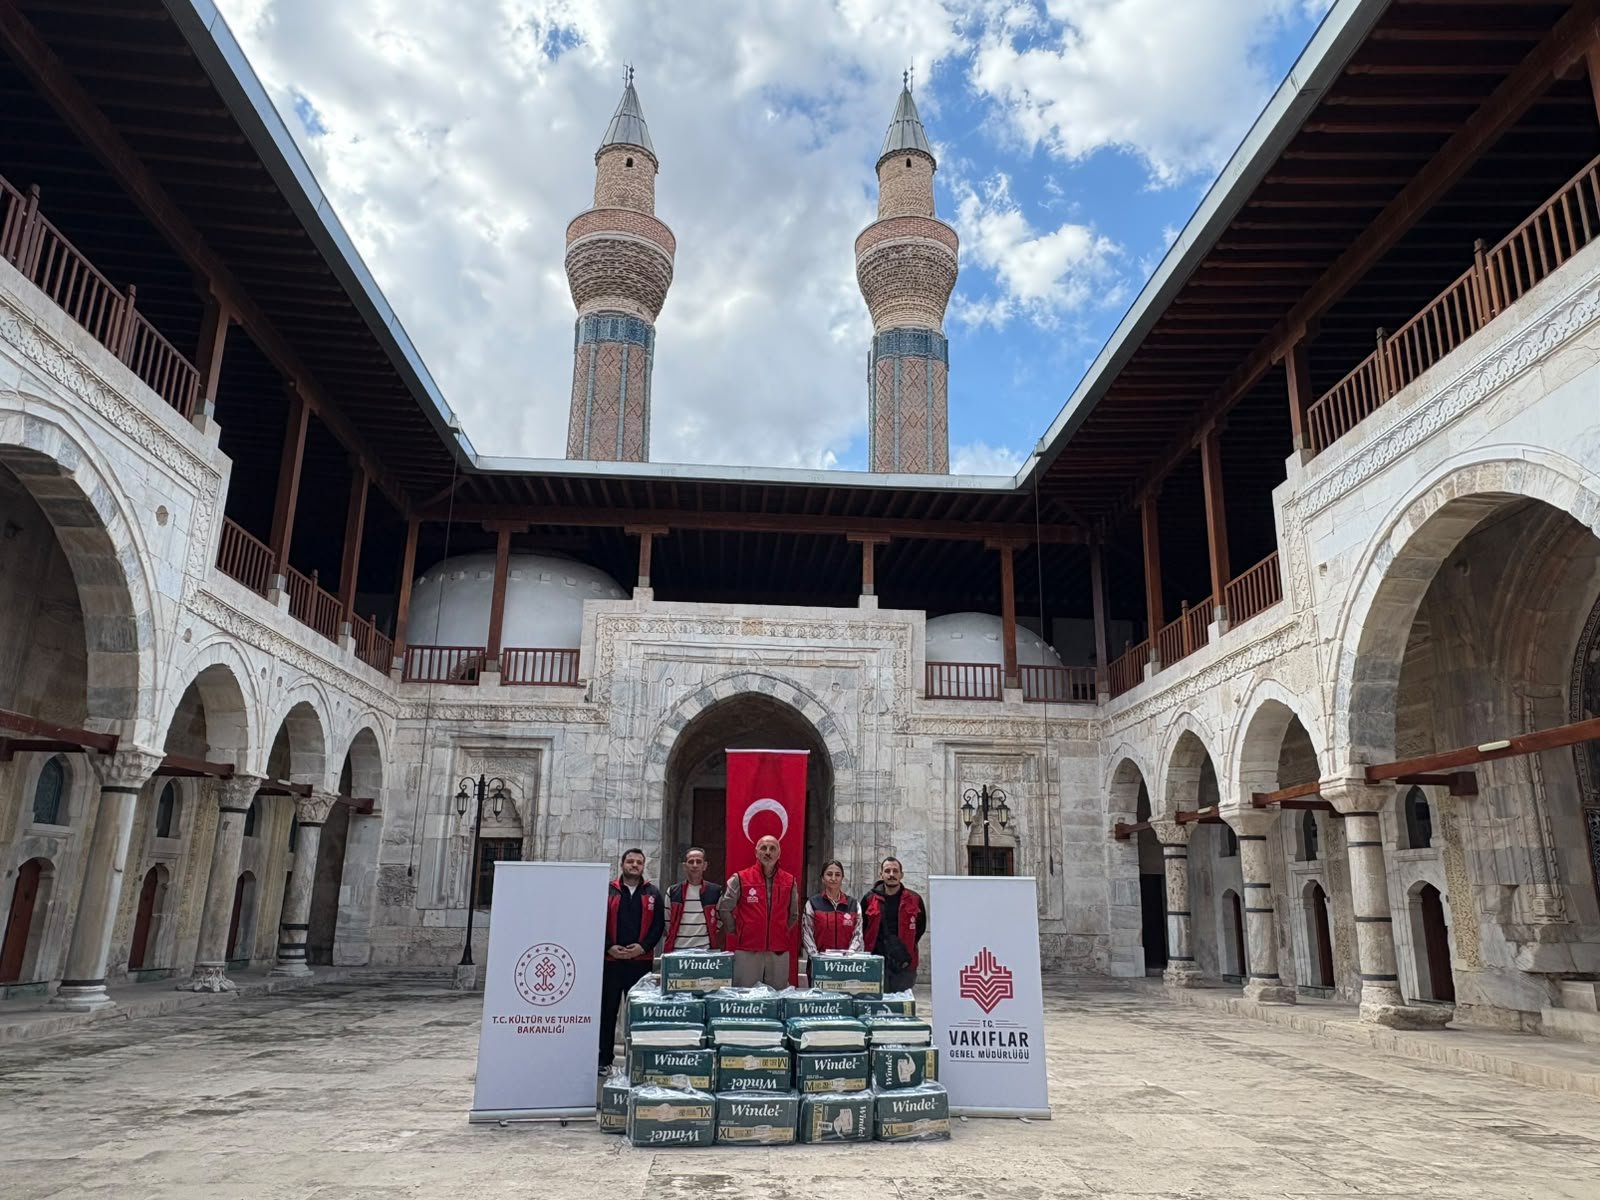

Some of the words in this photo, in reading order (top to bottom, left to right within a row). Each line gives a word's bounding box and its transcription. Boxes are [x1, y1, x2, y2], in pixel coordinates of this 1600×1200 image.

[668, 980, 679, 989] XL
[492, 1016, 507, 1024] T.C.
[508, 1015, 542, 1024] KÜLTÜR
[545, 1016, 556, 1024] VE
[558, 1014, 591, 1024] TURİZM
[517, 1025, 565, 1034] BAKANLIĞI
[949, 1030, 1029, 1047] VAKIFLAR
[949, 1049, 975, 1058] GENEL
[978, 1048, 1029, 1060] MÜDÜRLÜĞÜ
[805, 1082, 814, 1091] M
[602, 1116, 615, 1126] XL
[719, 1127, 733, 1139] XL
[883, 1124, 896, 1136] XL
